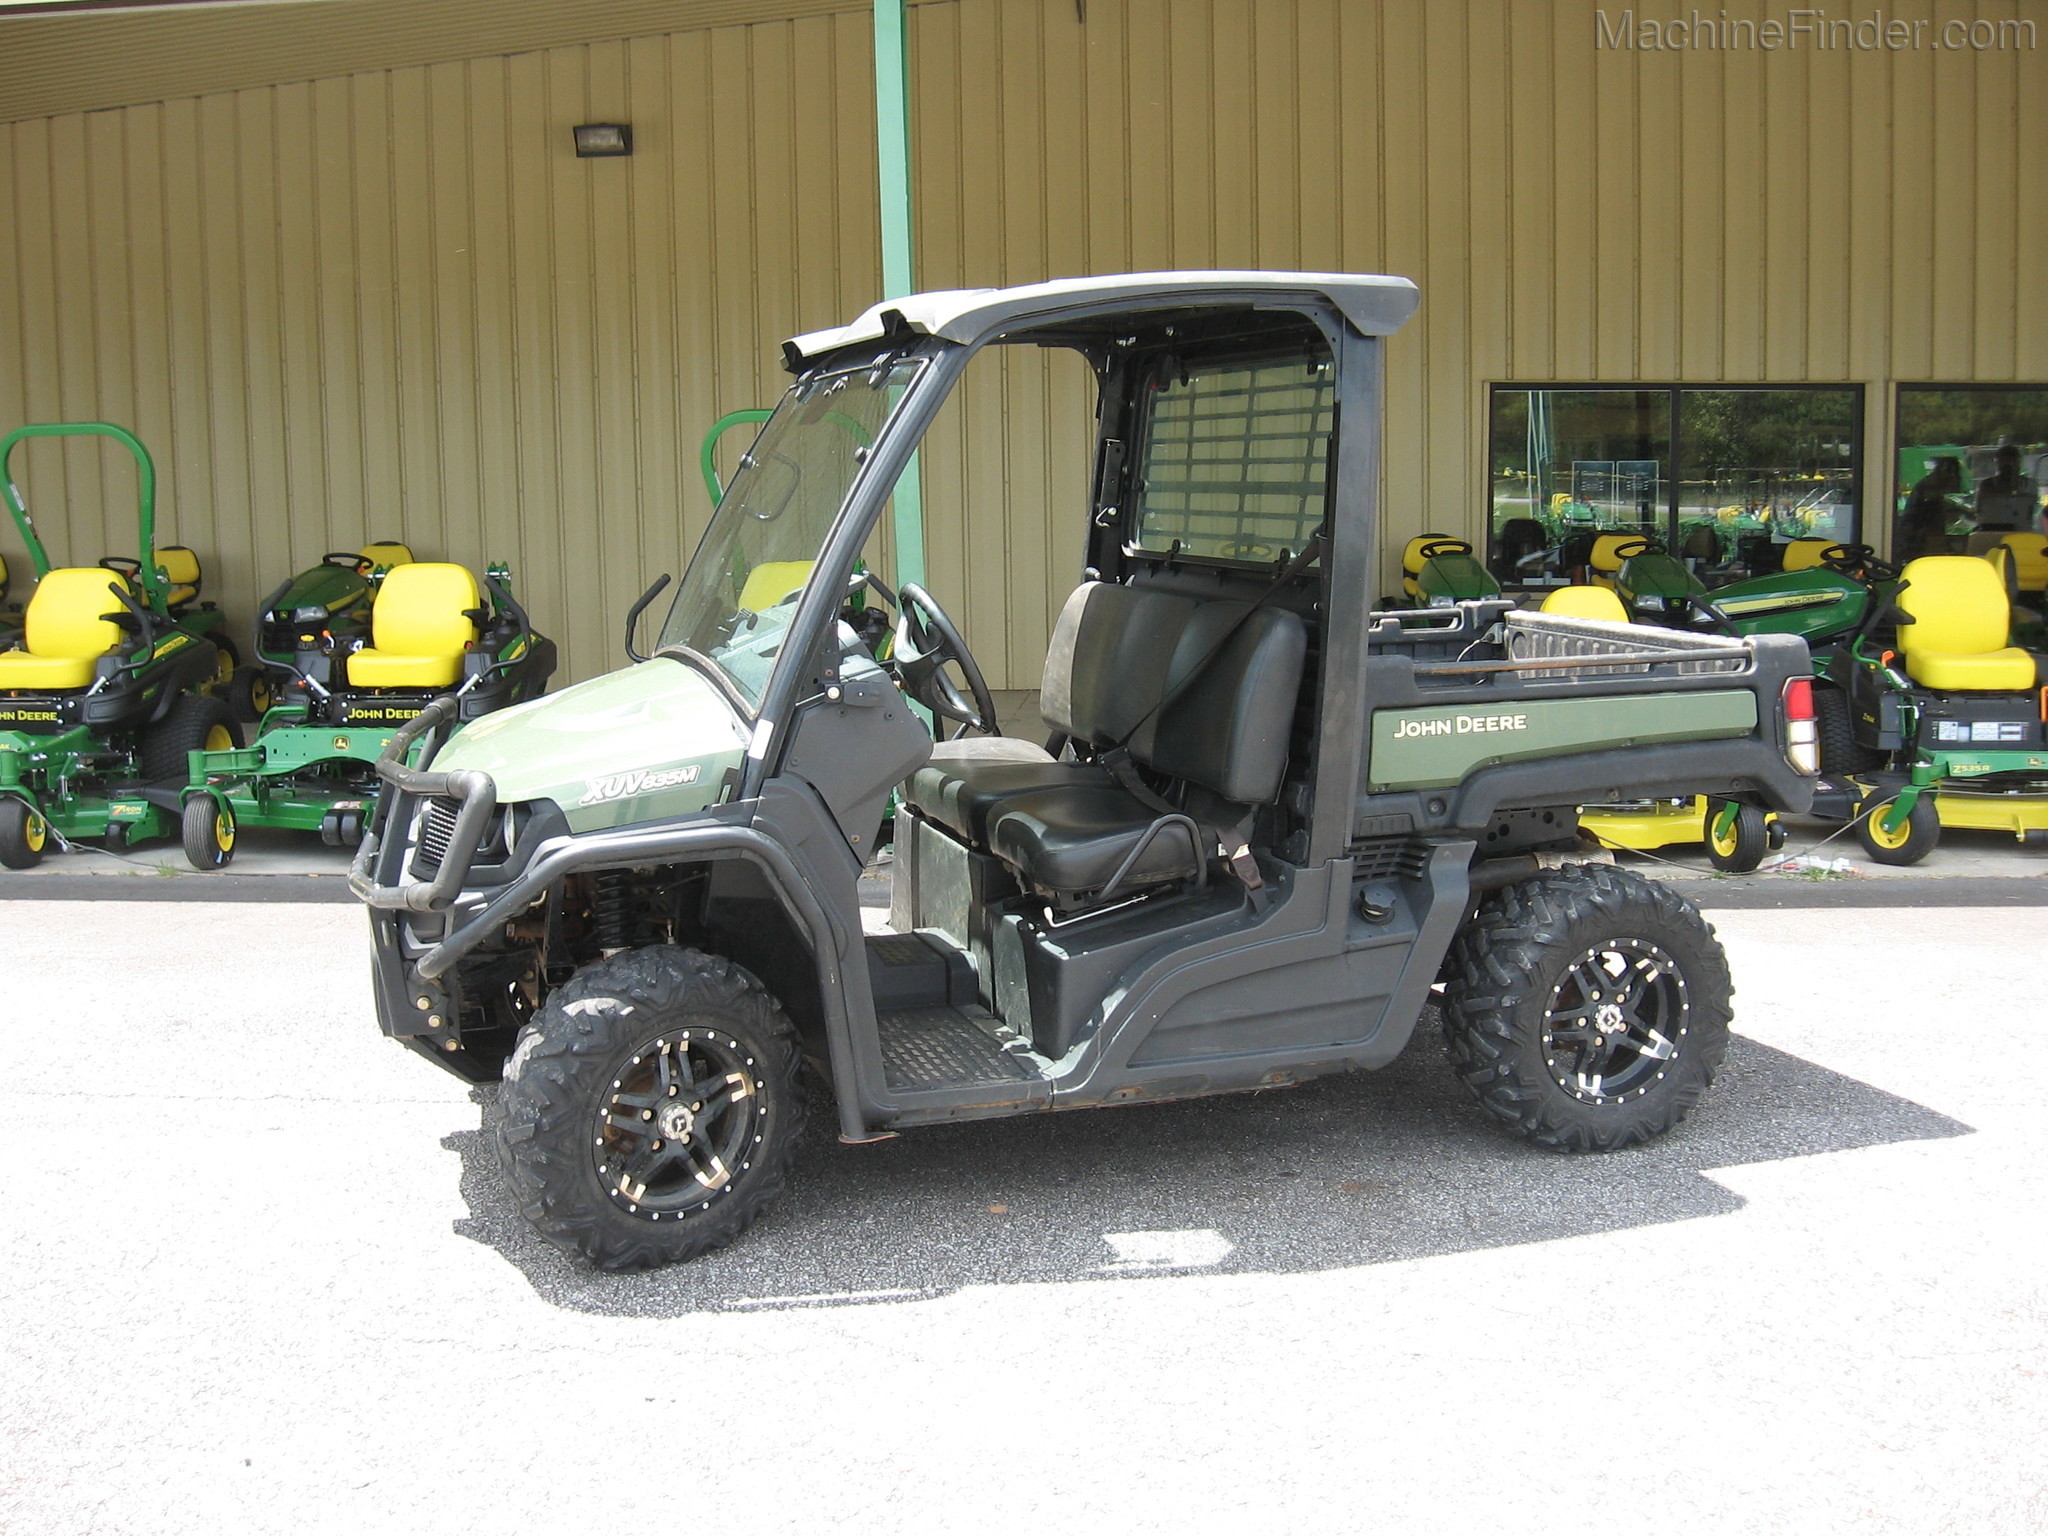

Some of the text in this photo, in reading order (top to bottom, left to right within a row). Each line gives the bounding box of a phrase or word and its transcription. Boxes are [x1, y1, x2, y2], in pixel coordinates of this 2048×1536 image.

[0, 710, 58, 720] HN DEERE
[348, 707, 383, 719] JOHN
[1393, 705, 1527, 738] JOHN DEERE
